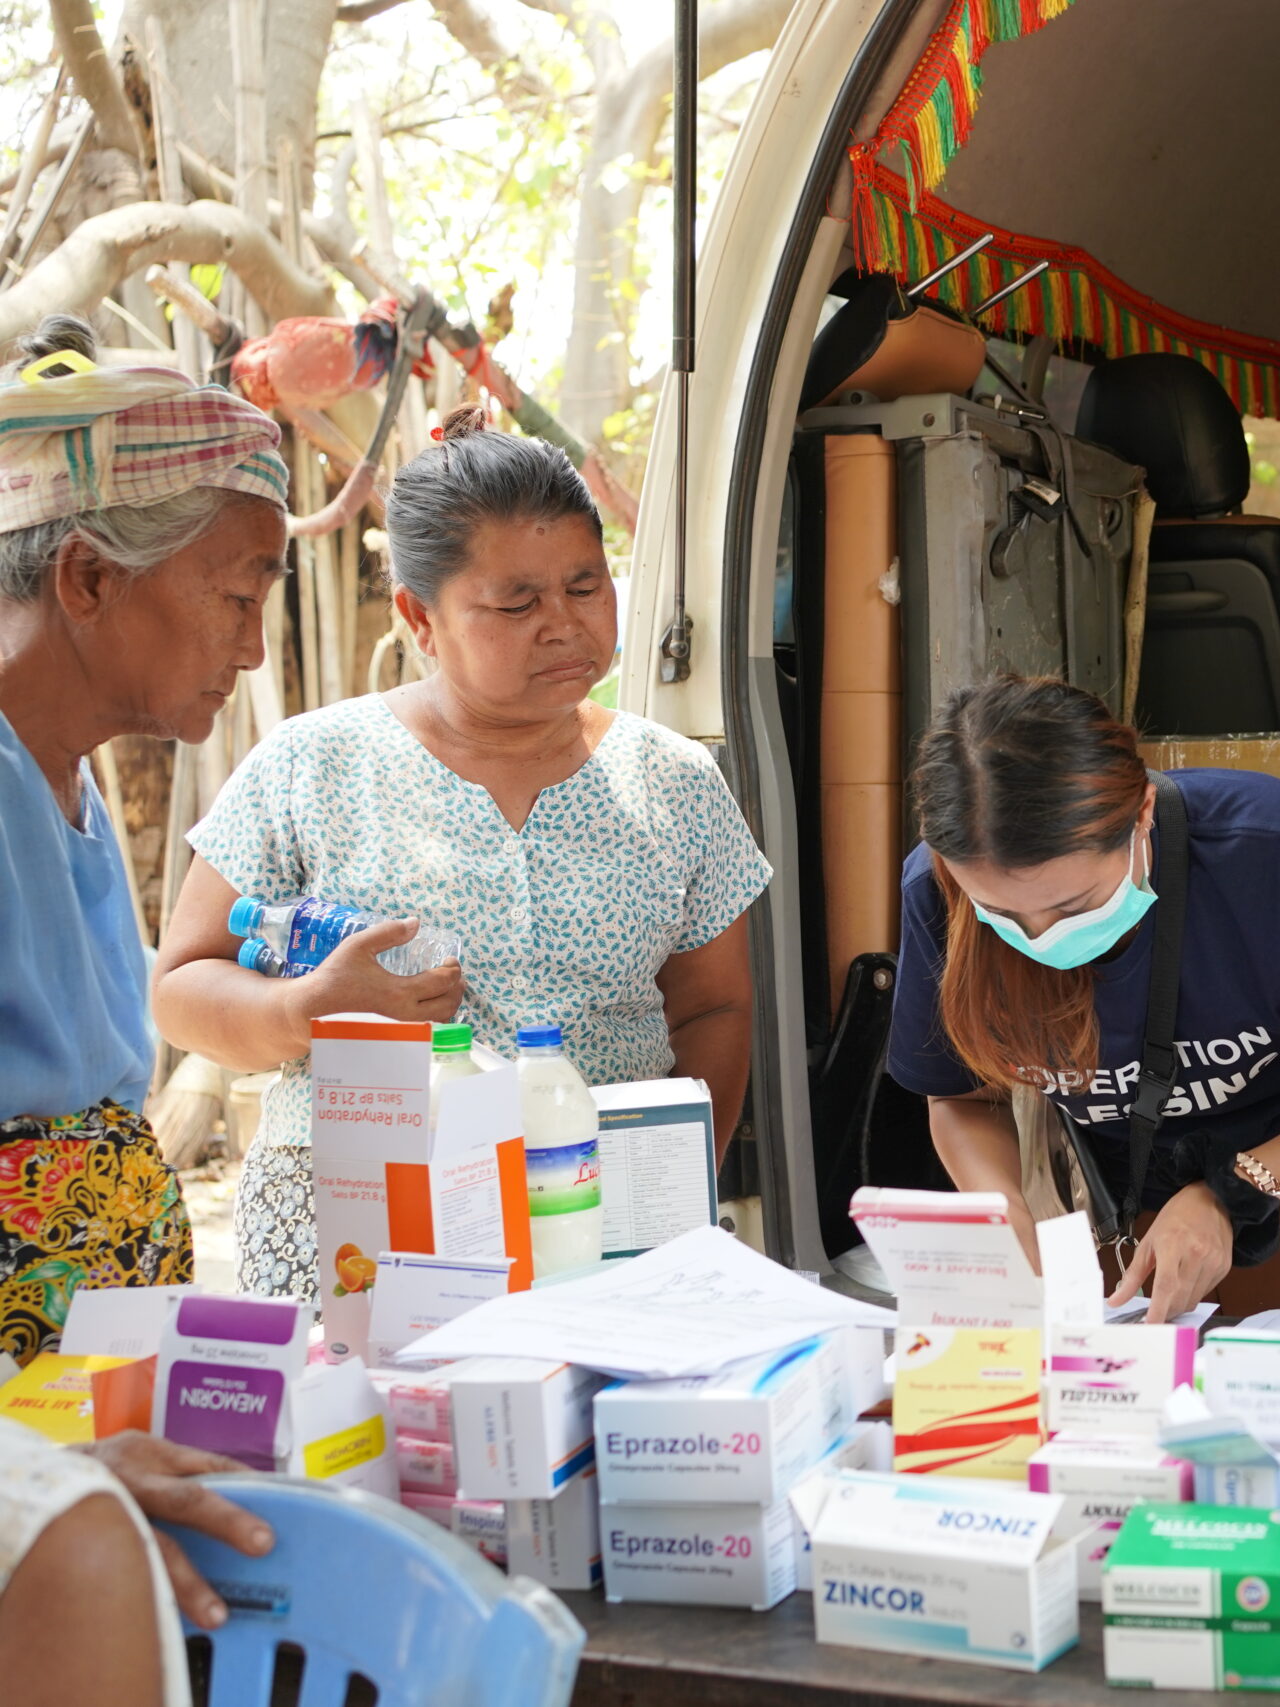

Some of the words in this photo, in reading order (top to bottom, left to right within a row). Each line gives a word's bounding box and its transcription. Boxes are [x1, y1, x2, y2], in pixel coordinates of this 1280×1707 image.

[1015, 1026, 1272, 1097] OPERTION
[329, 1091, 356, 1105] 21.8
[359, 1092, 374, 1104] BP
[377, 1092, 403, 1105] Salts
[318, 1108, 392, 1126] Rehydration
[397, 1112, 423, 1127] Oral
[179, 1386, 268, 1415] MEMORIN
[606, 1432, 762, 1460] Eprazole-20
[937, 1509, 1038, 1537] ZINCOR
[609, 1529, 752, 1559] Eprazole-20
[822, 1580, 926, 1615] ZINCOR
